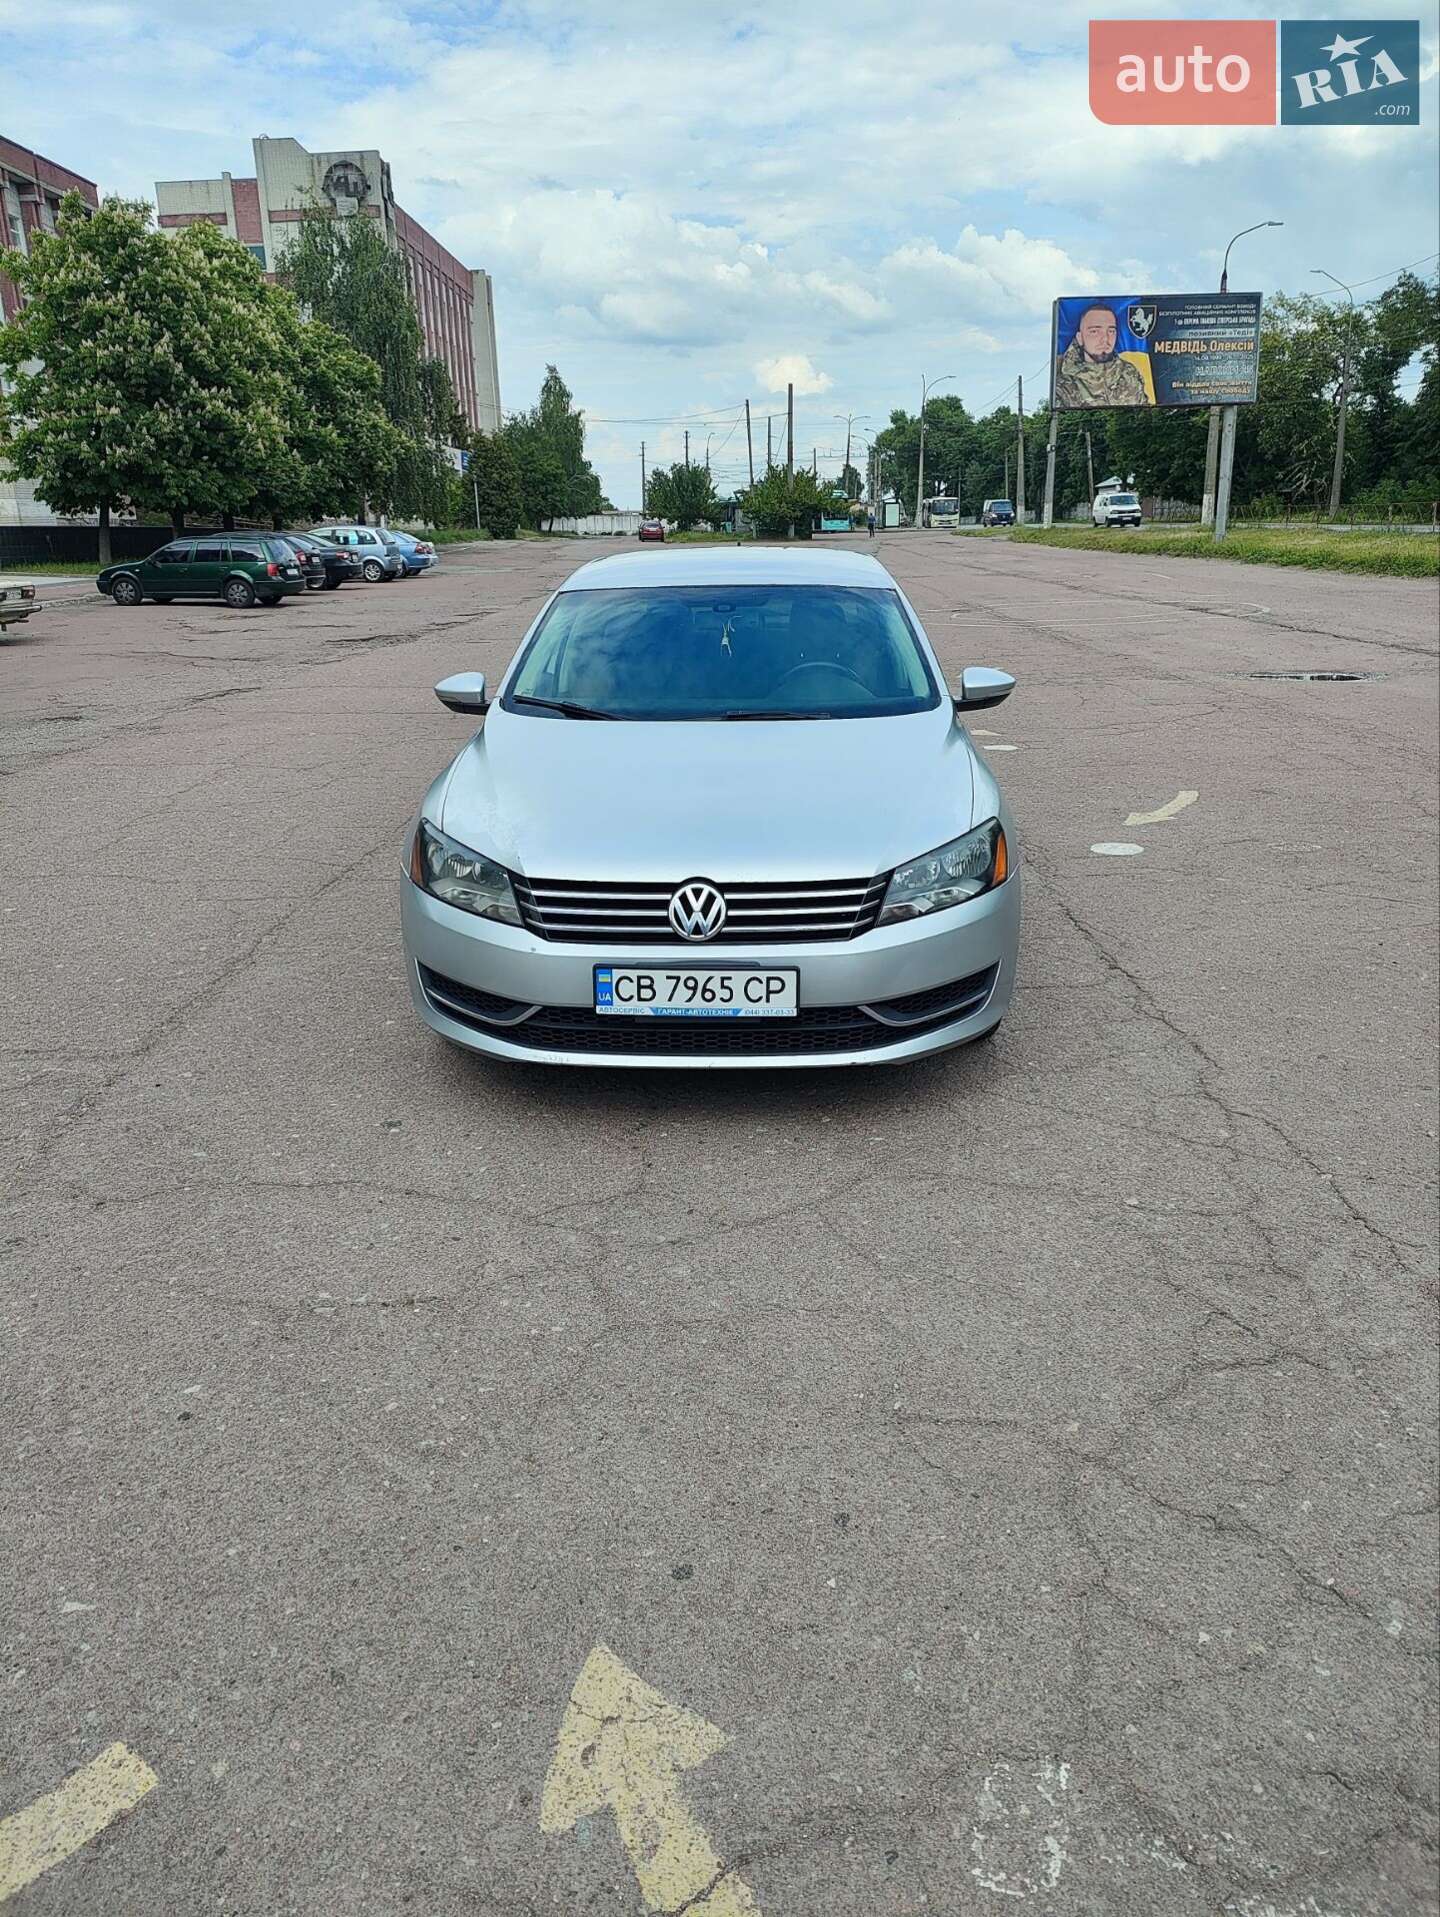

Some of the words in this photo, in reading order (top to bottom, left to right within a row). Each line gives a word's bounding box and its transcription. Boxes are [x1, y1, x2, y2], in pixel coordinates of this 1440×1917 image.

[1154, 340, 1207, 354] МЕДВІДЬ
[1210, 338, 1254, 352] Олексій
[598, 992, 612, 1002] UA
[665, 975, 734, 1003] 7965
